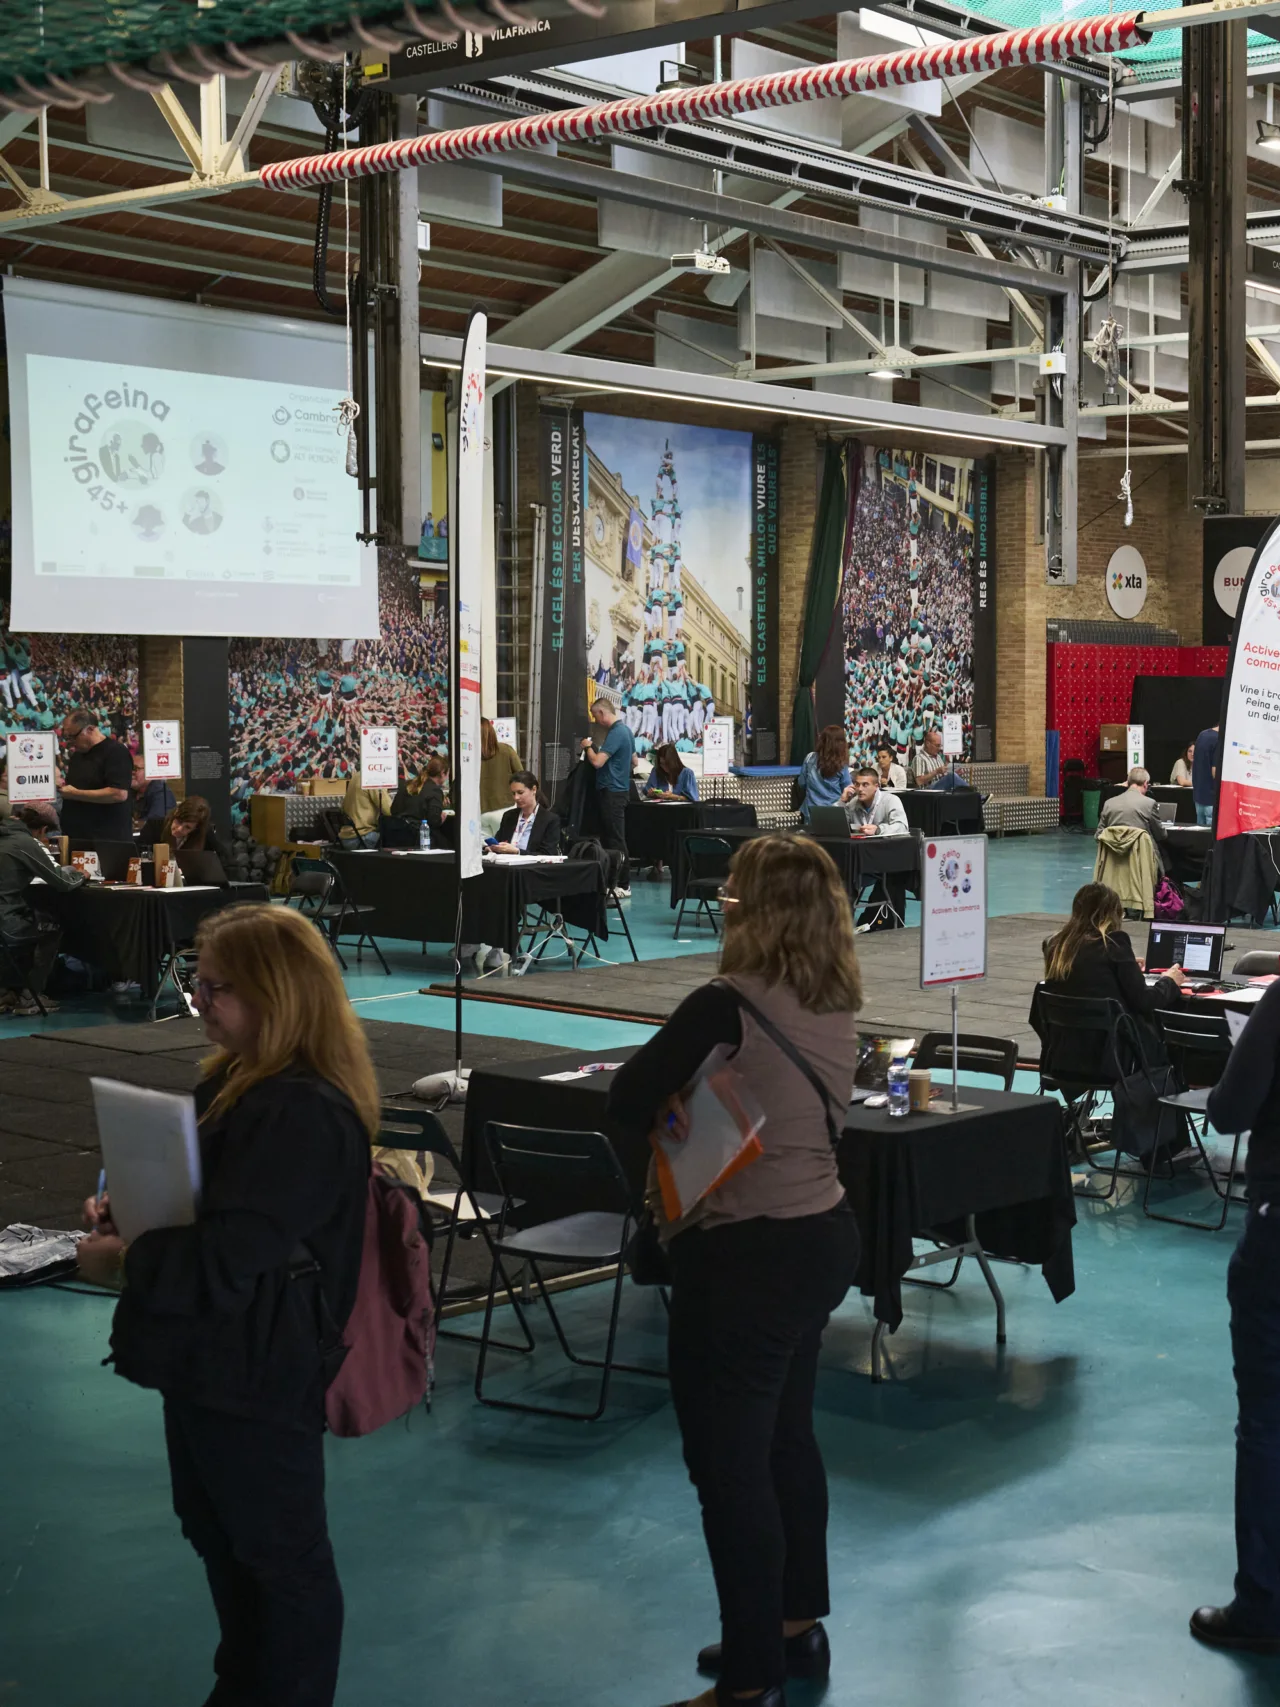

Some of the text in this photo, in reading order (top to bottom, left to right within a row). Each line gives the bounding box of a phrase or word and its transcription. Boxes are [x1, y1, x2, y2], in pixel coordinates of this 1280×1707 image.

[406, 19, 551, 59] CASTELLERS VILAFRANCA
[294, 409, 338, 424] Cambra
[86, 484, 128, 514] 45+
[551, 480, 563, 536] COLOR
[572, 426, 581, 583] PER DESCARREGAR
[552, 541, 563, 562] DE
[757, 513, 766, 567] MILLOR
[768, 523, 777, 555] QUE
[1125, 573, 1142, 589] xta
[552, 592, 563, 624] CEL
[1240, 684, 1260, 696] Vine
[1247, 710, 1280, 722] un dia!
[28, 774, 49, 784] IMAN
[72, 856, 96, 865] 2026
